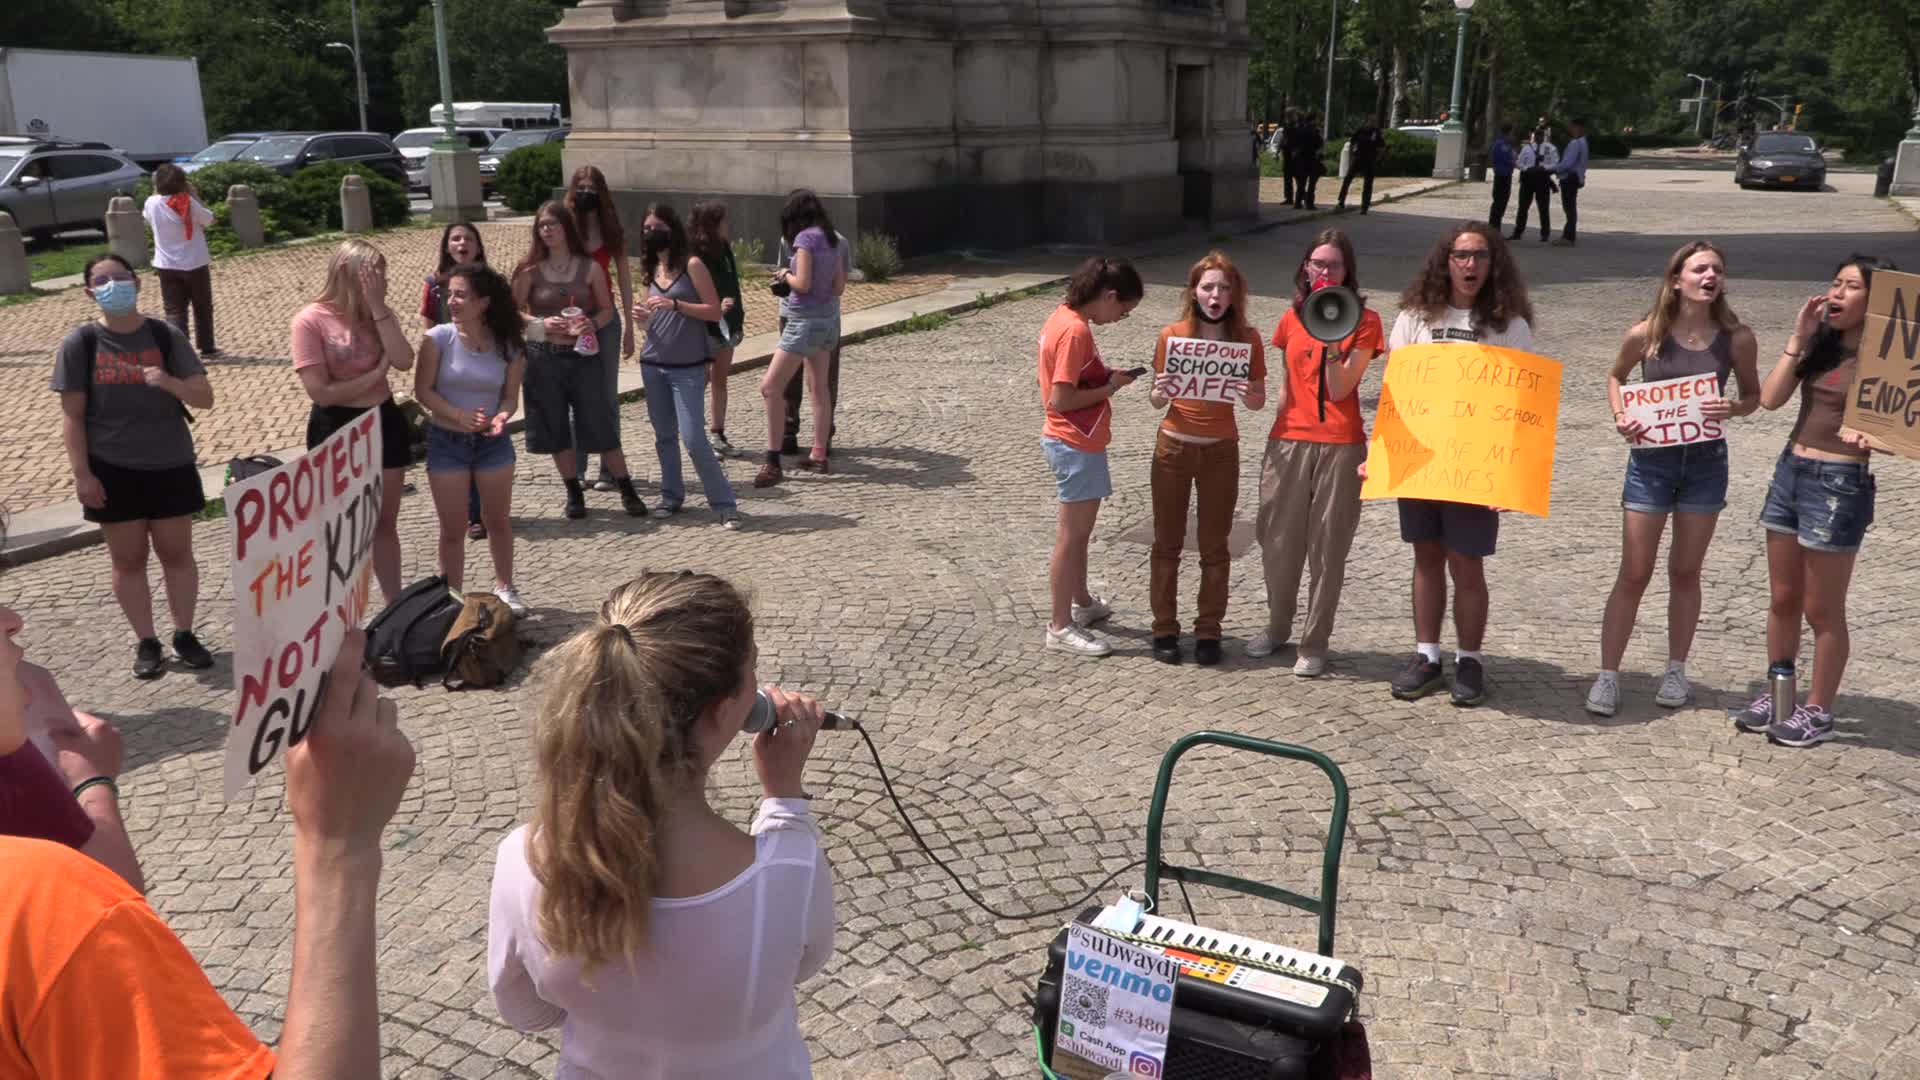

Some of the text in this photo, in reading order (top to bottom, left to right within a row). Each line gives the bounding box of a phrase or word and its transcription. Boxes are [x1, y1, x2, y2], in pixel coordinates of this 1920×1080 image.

[1169, 340, 1249, 360] KEEP OUR
[1166, 357, 1250, 378] SCHOOLS
[1394, 355, 1544, 392] THE SCARIEST
[1164, 375, 1241, 401] SAFE
[1623, 376, 1718, 408] PROTECT
[1448, 400, 1477, 418] IN
[1490, 405, 1545, 428] SCHOOL
[1653, 404, 1688, 420] THE
[1635, 418, 1723, 445] KIDS
[1447, 437, 1474, 463] BE
[1483, 444, 1521, 465] MY
[234, 411, 376, 561] PROTECT
[248, 538, 315, 617] THE
[235, 609, 329, 726] NOT
[1069, 925, 1177, 984] @subwaydj
[1067, 949, 1172, 1002] venmo
[1113, 1007, 1166, 1035] #3480
[1079, 1030, 1127, 1056] Cash App
